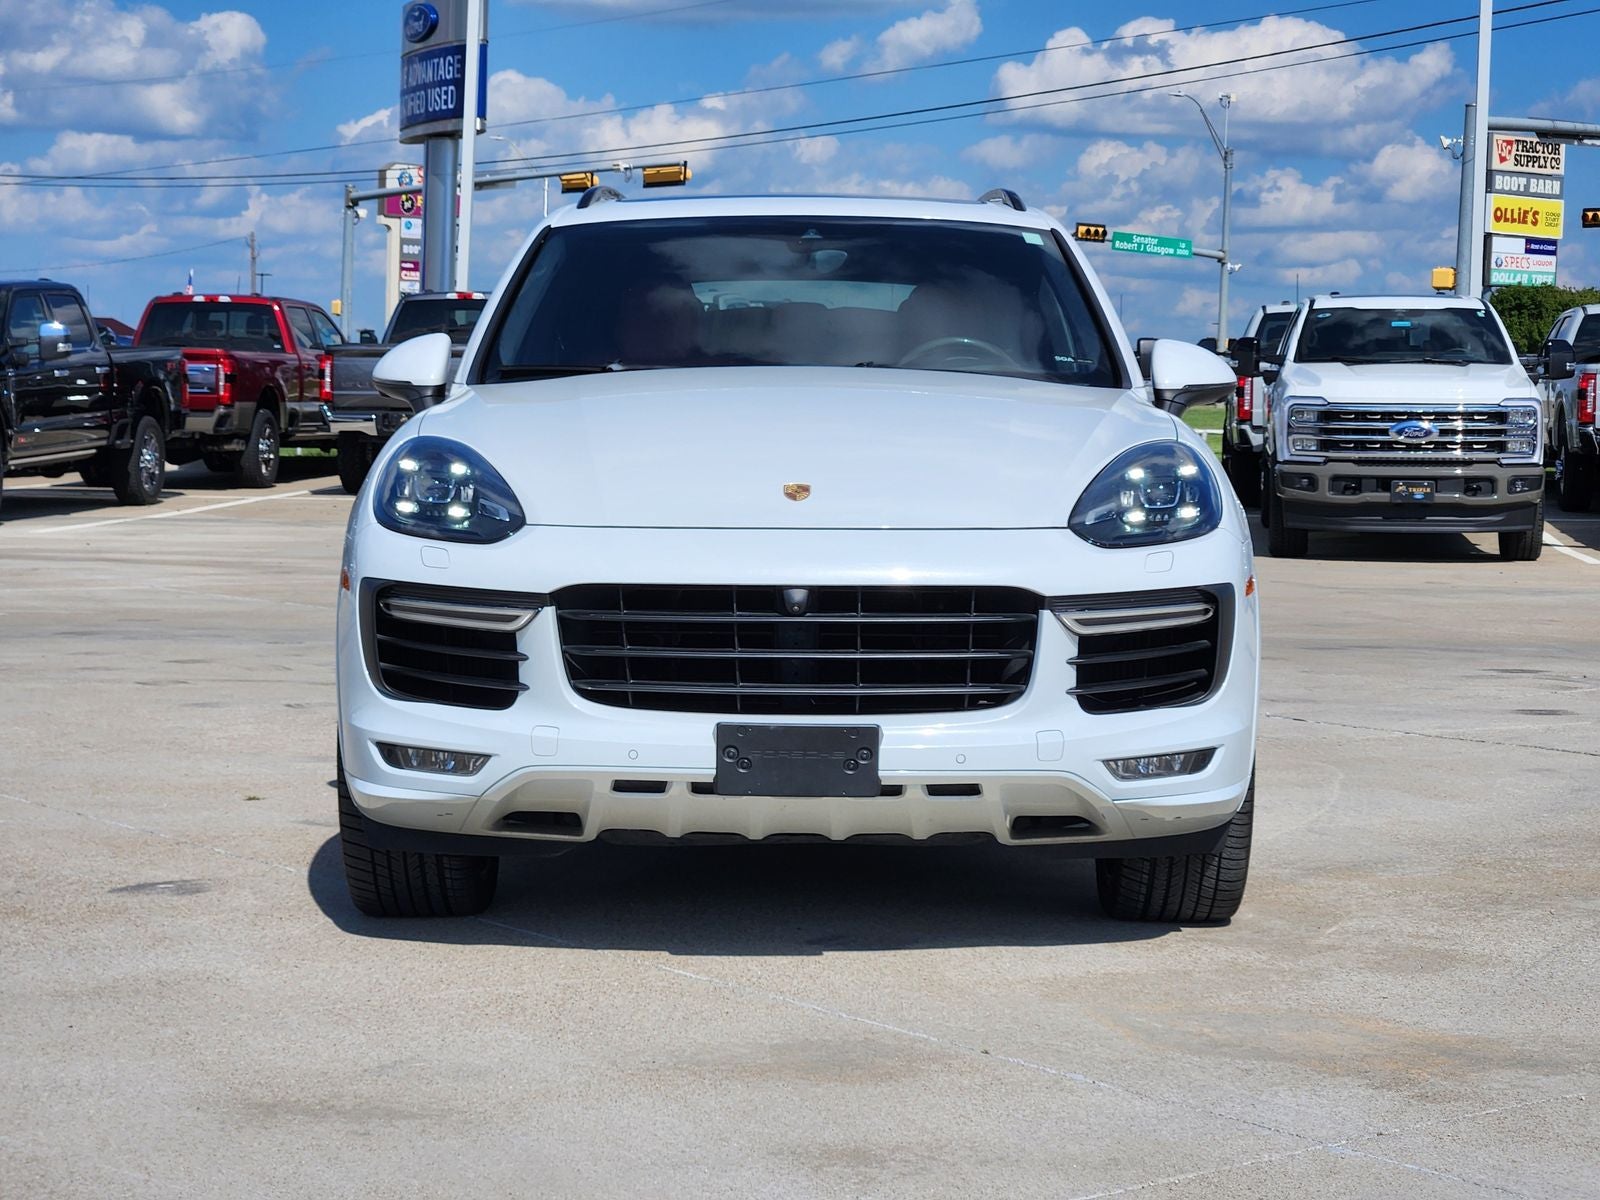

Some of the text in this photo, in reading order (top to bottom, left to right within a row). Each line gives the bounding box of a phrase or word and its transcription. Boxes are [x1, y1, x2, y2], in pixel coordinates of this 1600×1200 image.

[408, 55, 462, 88] ADVANTAGE
[427, 85, 457, 112] USED
[1497, 139, 1512, 160] TSC
[1515, 139, 1561, 156] TRACTOR
[1514, 153, 1549, 169] SUPPLY
[1495, 175, 1561, 194] BOOT BARN
[1114, 240, 1138, 250] Robert
[1146, 244, 1175, 255] Glasgow
[1132, 235, 1159, 245] Senator
[1492, 272, 1553, 285] DOLLAR TREE
[1402, 427, 1426, 437] Ford
